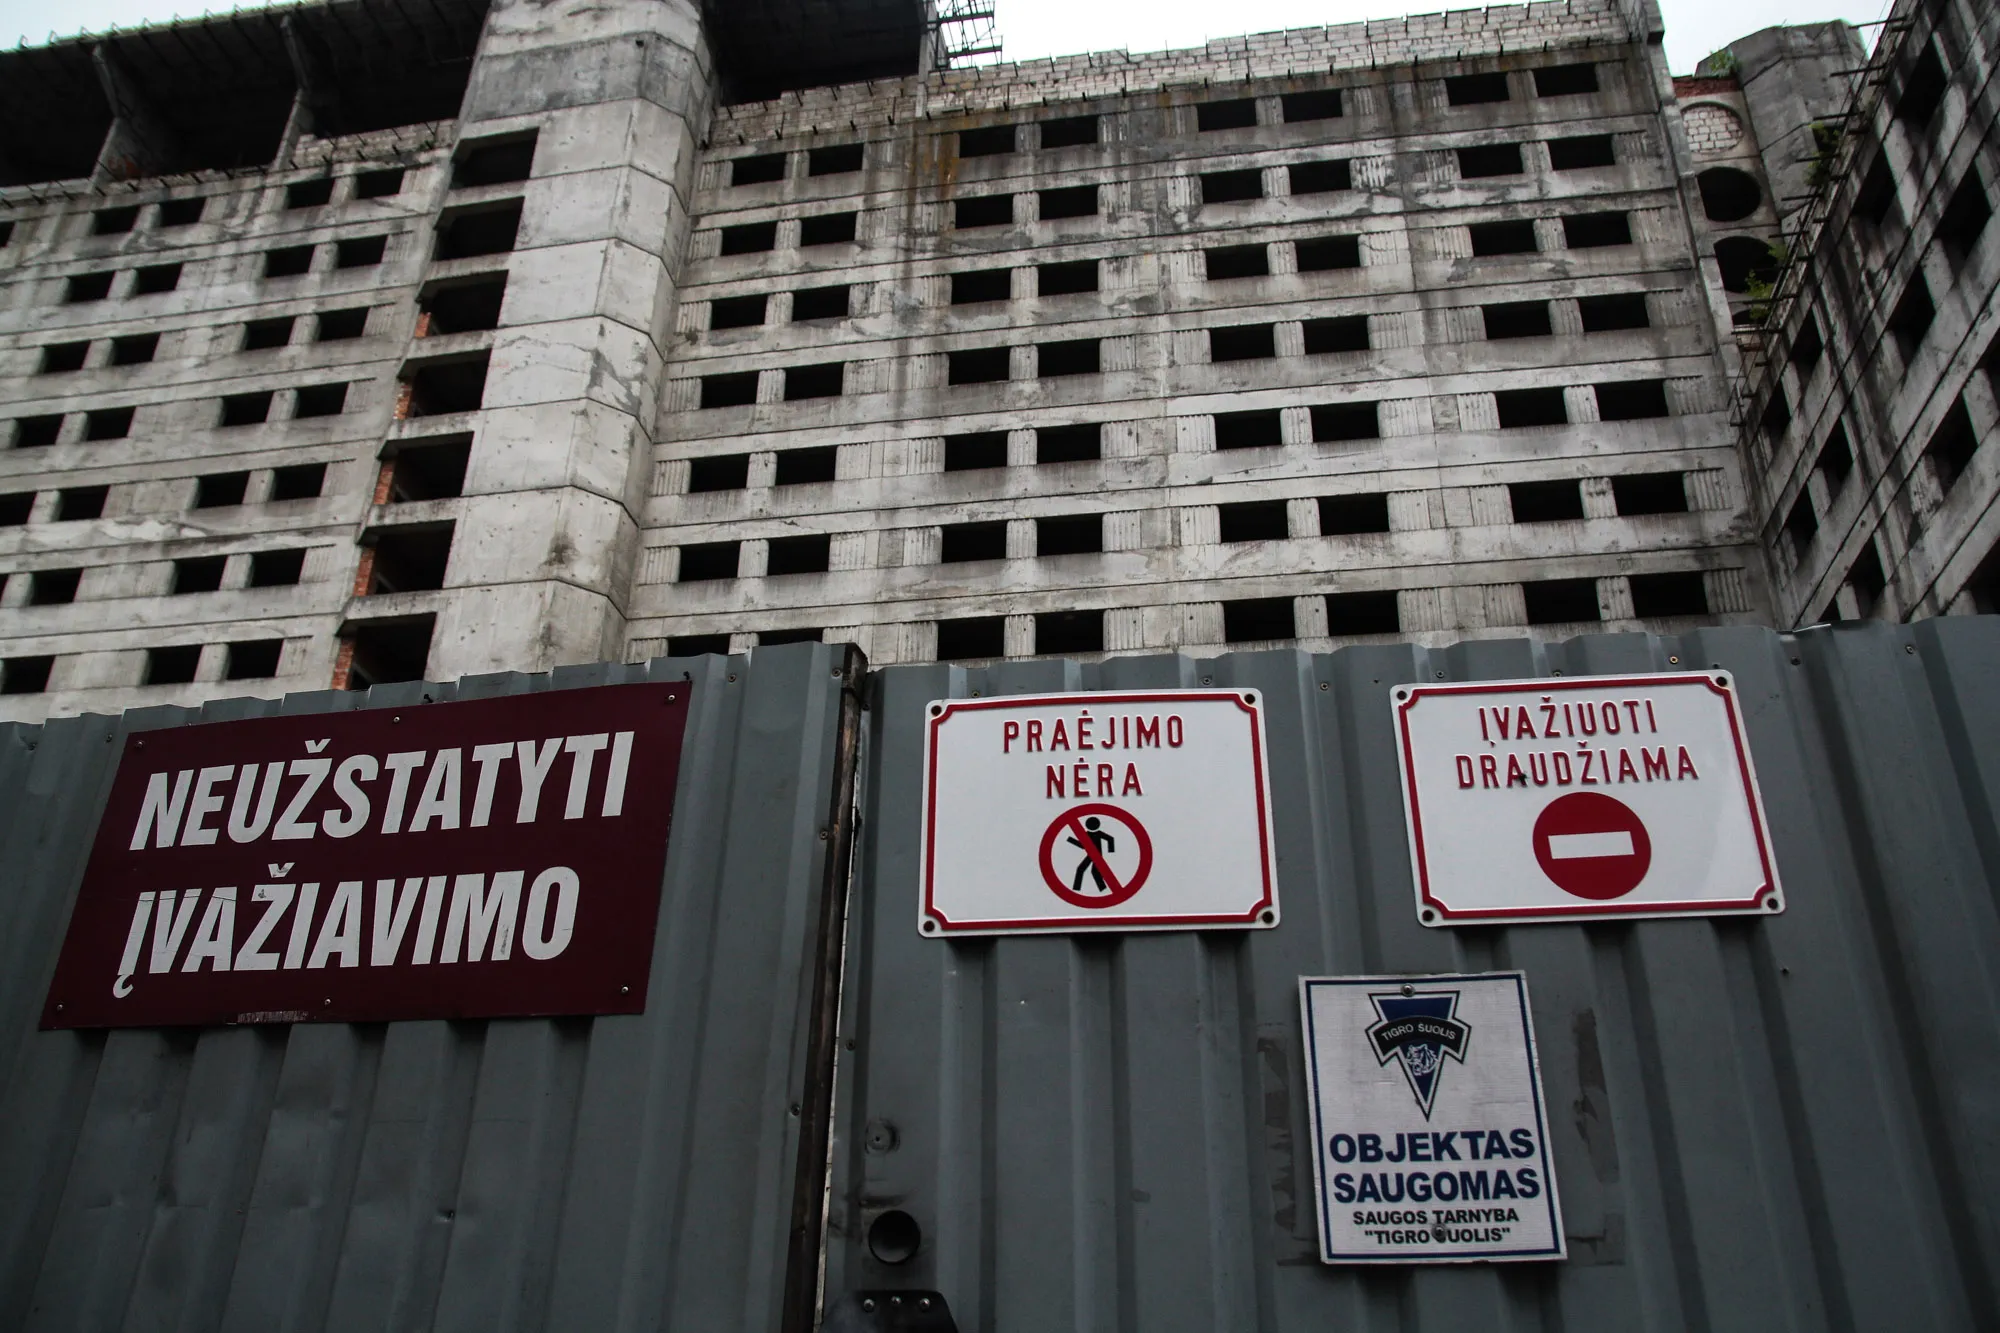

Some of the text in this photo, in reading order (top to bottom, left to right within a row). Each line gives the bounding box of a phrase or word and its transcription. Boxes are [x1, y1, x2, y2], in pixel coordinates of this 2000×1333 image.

[1003, 709, 1184, 753] PRAĖJIMO
[1478, 696, 1657, 746] ĮVAŽIUOTI
[1046, 757, 1143, 799] NĖRA
[1456, 740, 1698, 788] DRAUDŽIAMA
[129, 730, 636, 851] NEUŽSTATYTI
[112, 862, 580, 998] ĮVAŽIAVIMO
[1381, 1023, 1414, 1042] TIGRO
[1329, 1128, 1535, 1163] OBJEKTAS
[1334, 1167, 1540, 1203] SAUGOMAS
[1353, 1208, 1519, 1225] SAUGOS TARNYBA
[1365, 1226, 1511, 1244] "TIGRO UOLIS"
